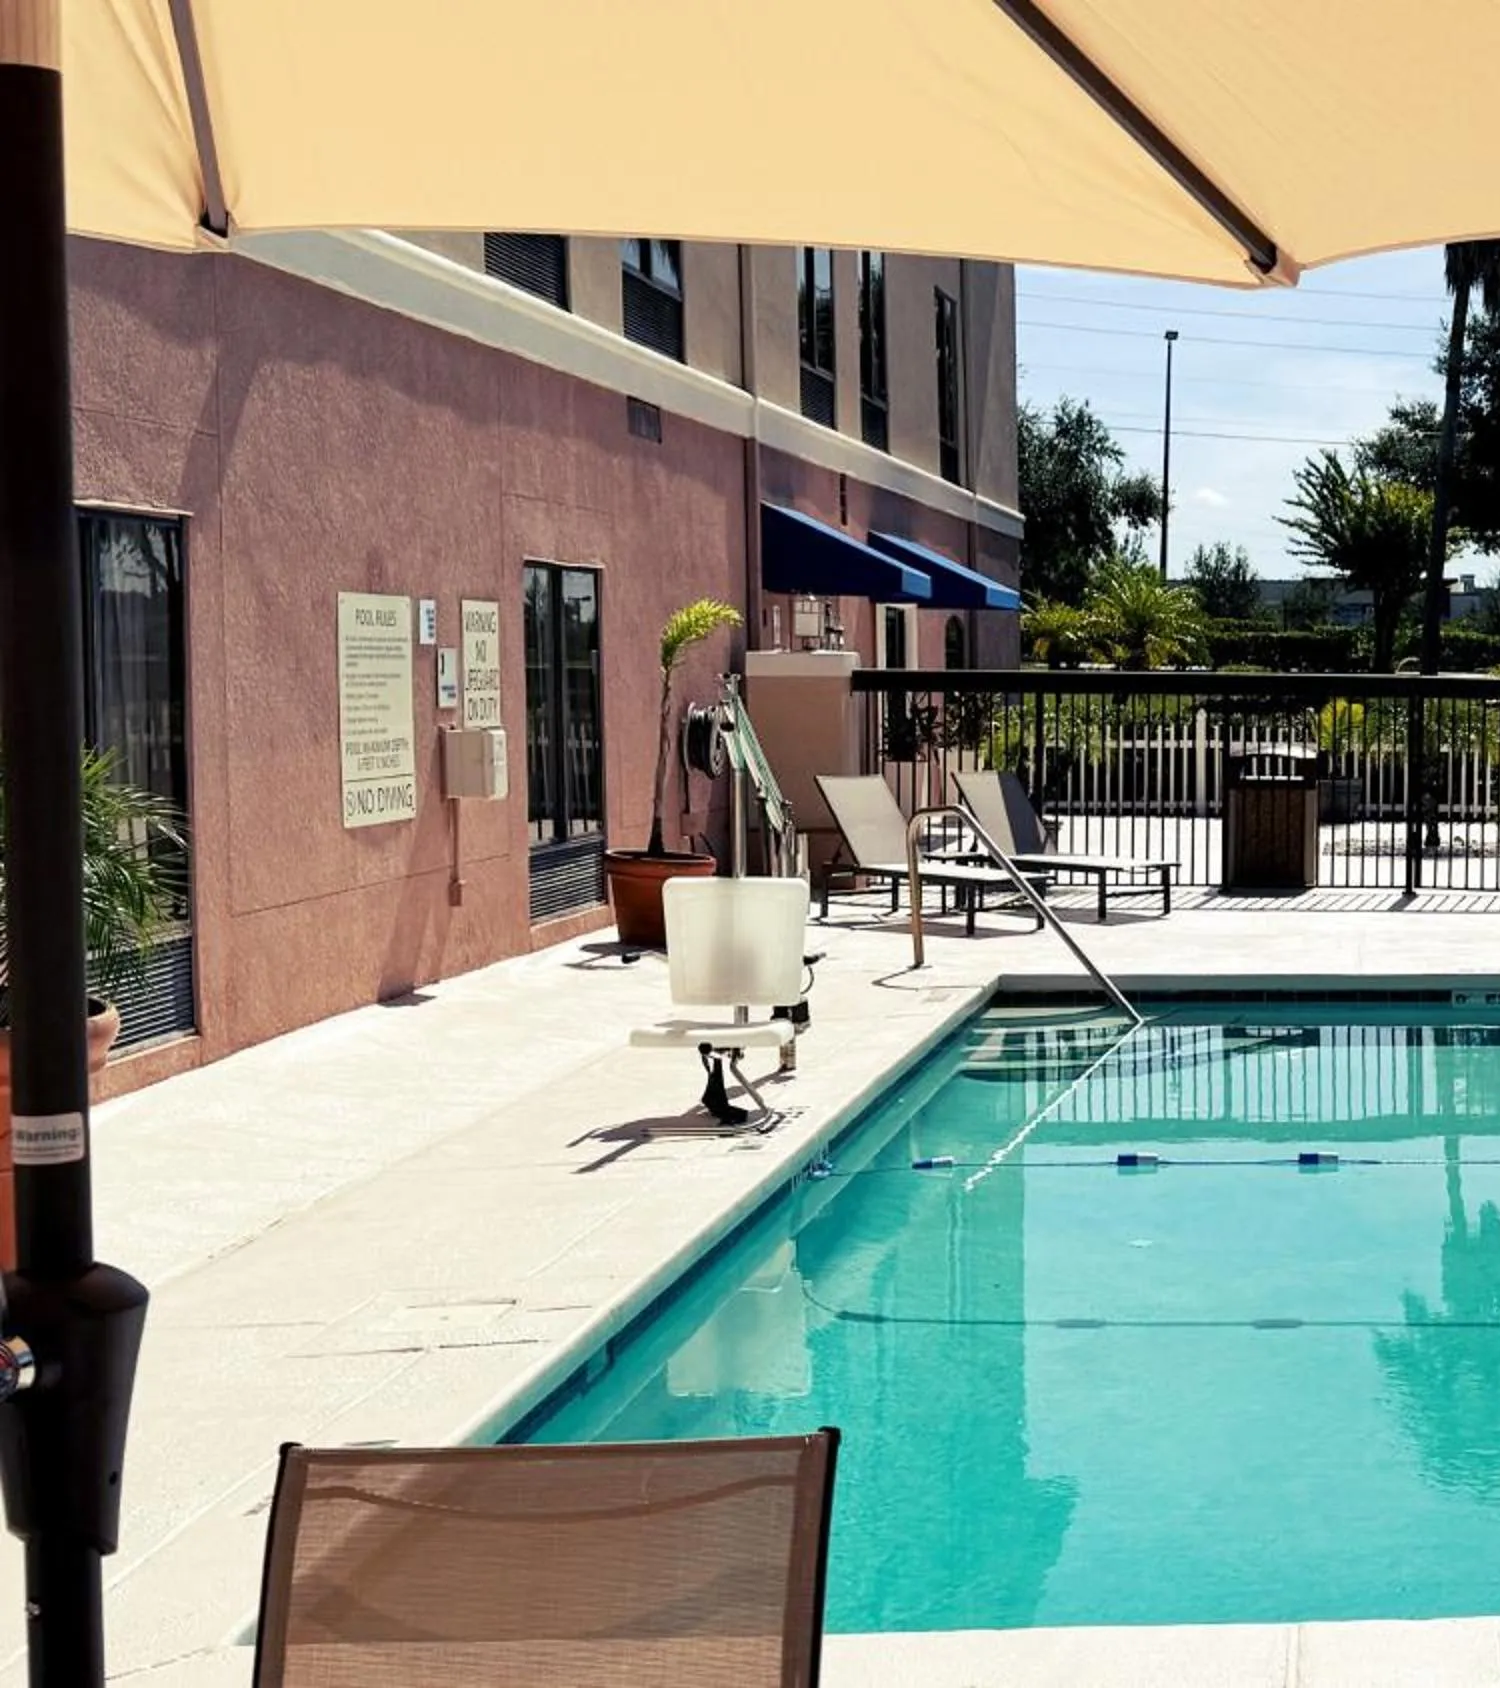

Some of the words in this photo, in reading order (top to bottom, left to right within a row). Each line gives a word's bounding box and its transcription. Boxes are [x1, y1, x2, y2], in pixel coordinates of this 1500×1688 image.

[355, 607, 374, 627] POOL
[375, 609, 397, 627] RULES
[464, 610, 496, 634] WARNING
[475, 639, 487, 663] NO
[468, 697, 479, 721] ON
[480, 697, 498, 720] DUTY
[357, 787, 375, 815] NO
[377, 783, 413, 813] DIVING
